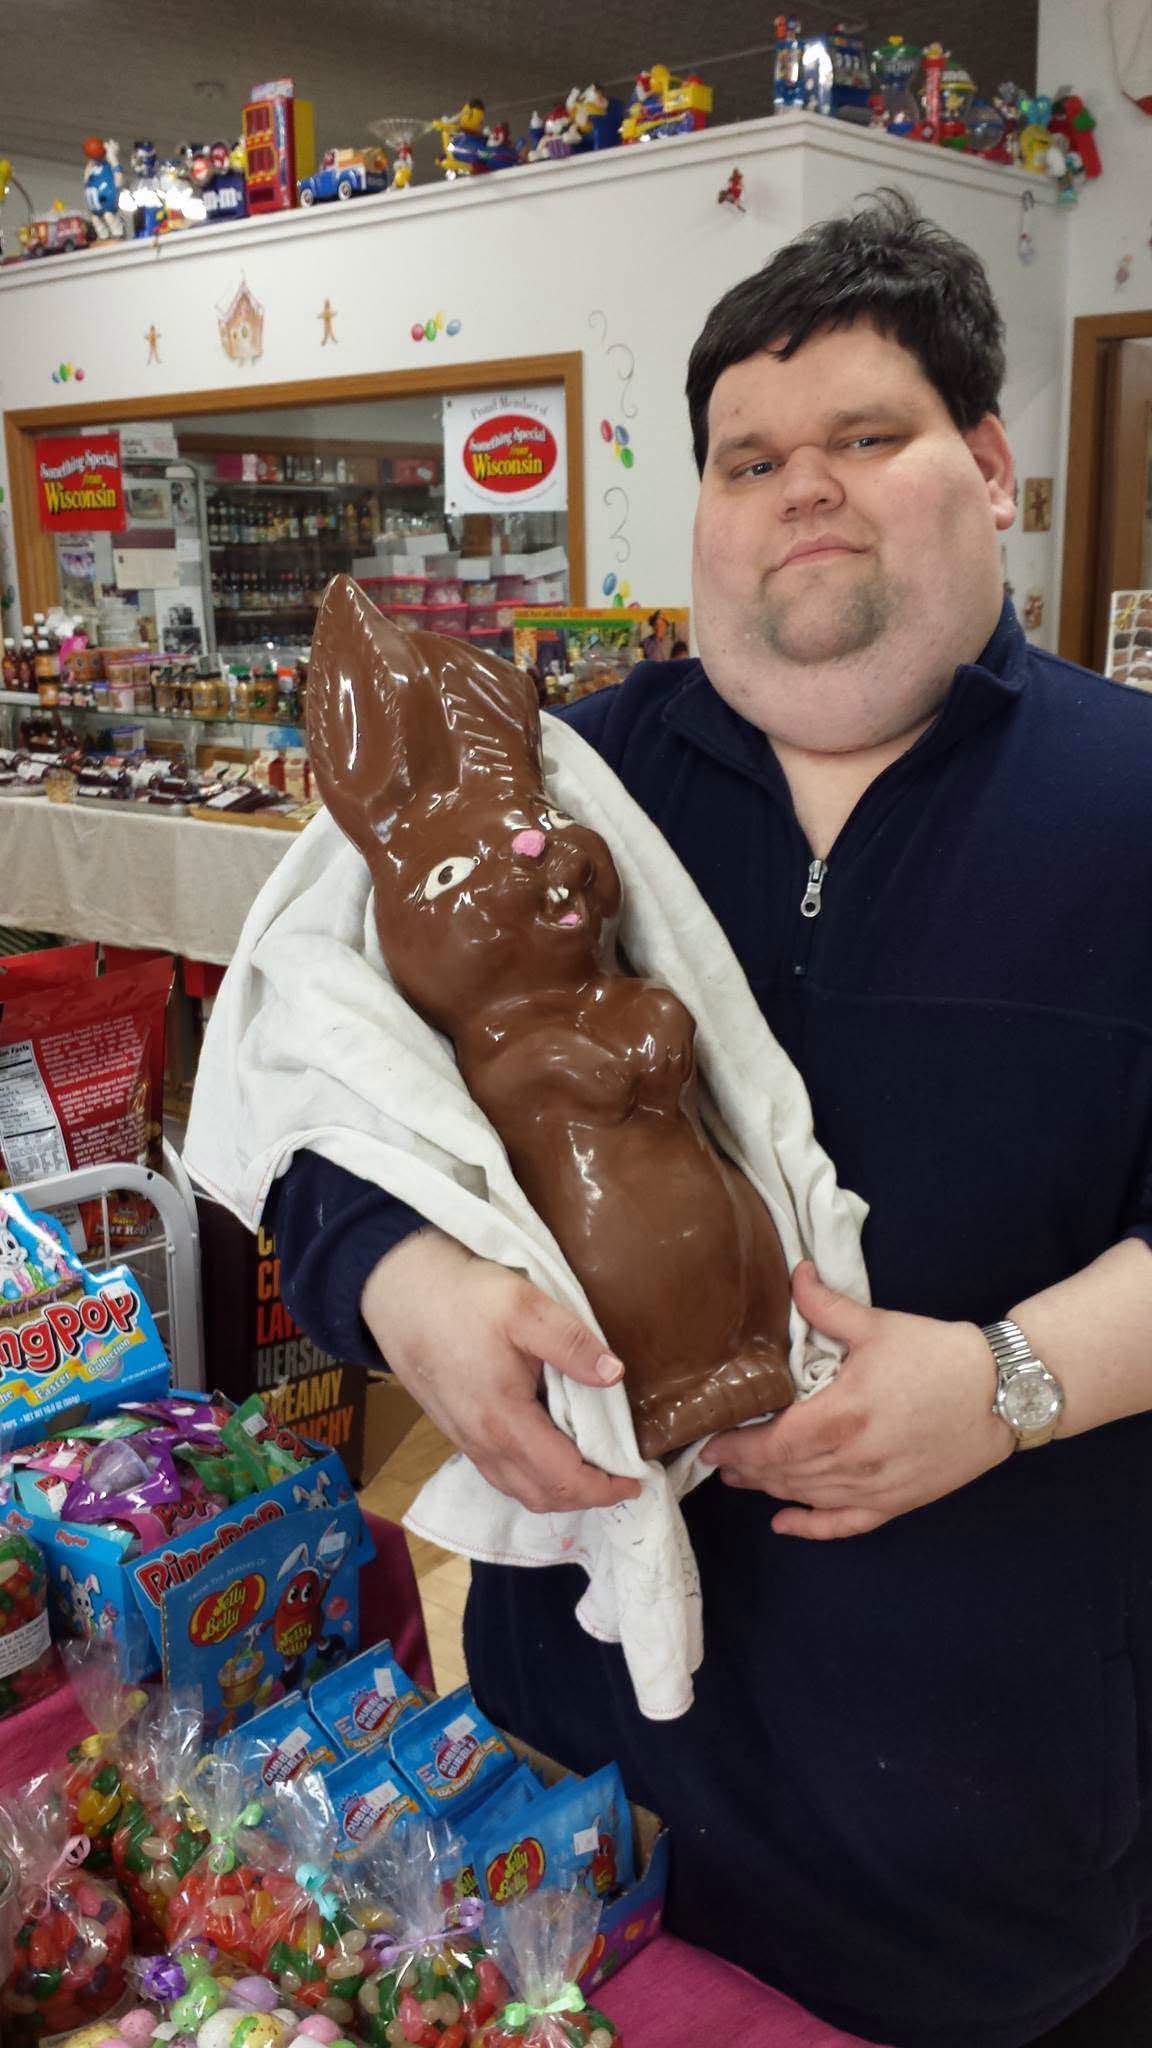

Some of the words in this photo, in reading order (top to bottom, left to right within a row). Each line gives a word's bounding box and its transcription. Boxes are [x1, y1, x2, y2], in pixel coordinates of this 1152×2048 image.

[470, 432, 514, 453] Something
[513, 427, 547, 443] Special
[510, 446, 530, 457] from
[40, 454, 86, 480] Something
[84, 449, 118, 471] Special
[471, 451, 543, 480] Wisconsin
[44, 481, 117, 515] Wisconsin
[35, 1370, 71, 1400] Easter
[87, 1336, 131, 1376] Collection
[213, 1583, 247, 1617] Jelly
[202, 1609, 240, 1641] Belly
[505, 1848, 529, 1878] Jelly
